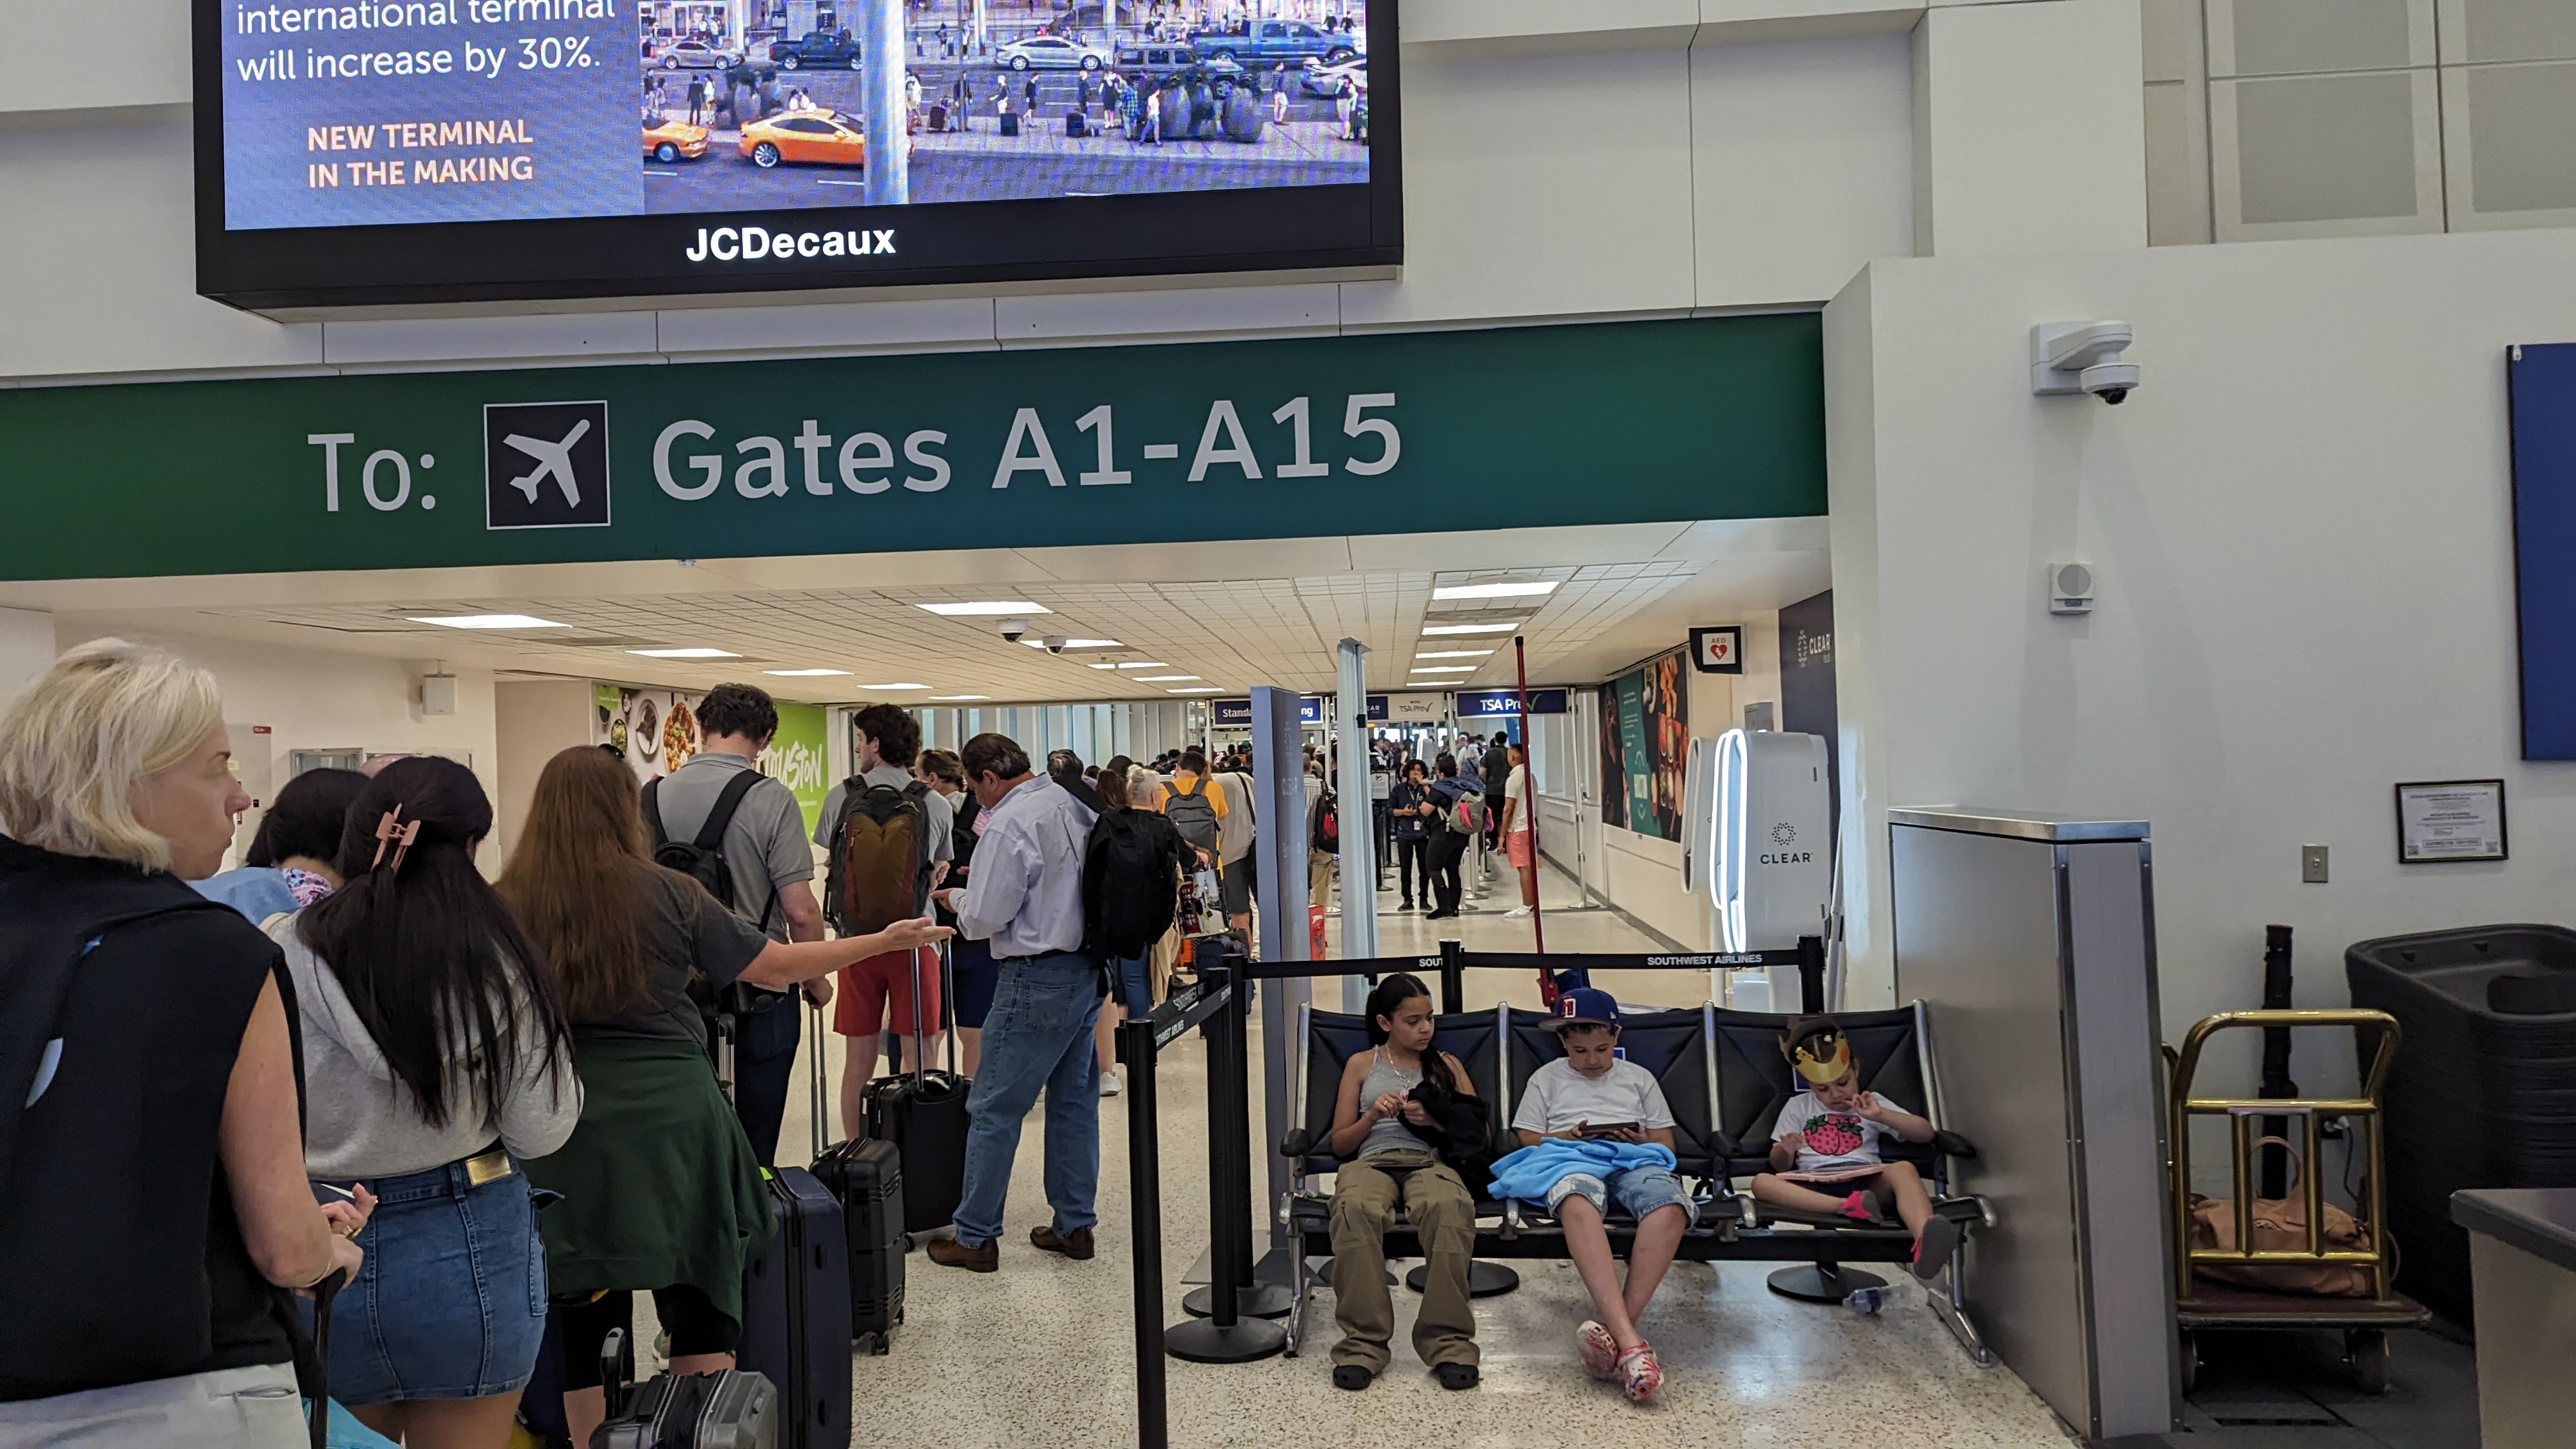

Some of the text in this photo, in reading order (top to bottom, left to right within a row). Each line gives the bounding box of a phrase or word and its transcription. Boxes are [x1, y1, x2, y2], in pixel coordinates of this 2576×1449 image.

[238, 0, 615, 34] international terminal
[238, 36, 601, 81] will increase by 30%.
[308, 119, 534, 151] NEW TERMINAL
[309, 156, 534, 188] IN THE MAKING
[686, 227, 896, 261] JCDecaux
[307, 392, 1401, 511] To: Gates A1-A15
[1809, 633, 1831, 655] CLEAR
[1480, 699, 1503, 711] TSA
[1760, 852, 1811, 864] CLEAR
[1647, 954, 1763, 966] SOUTHWEST AIRLINES
